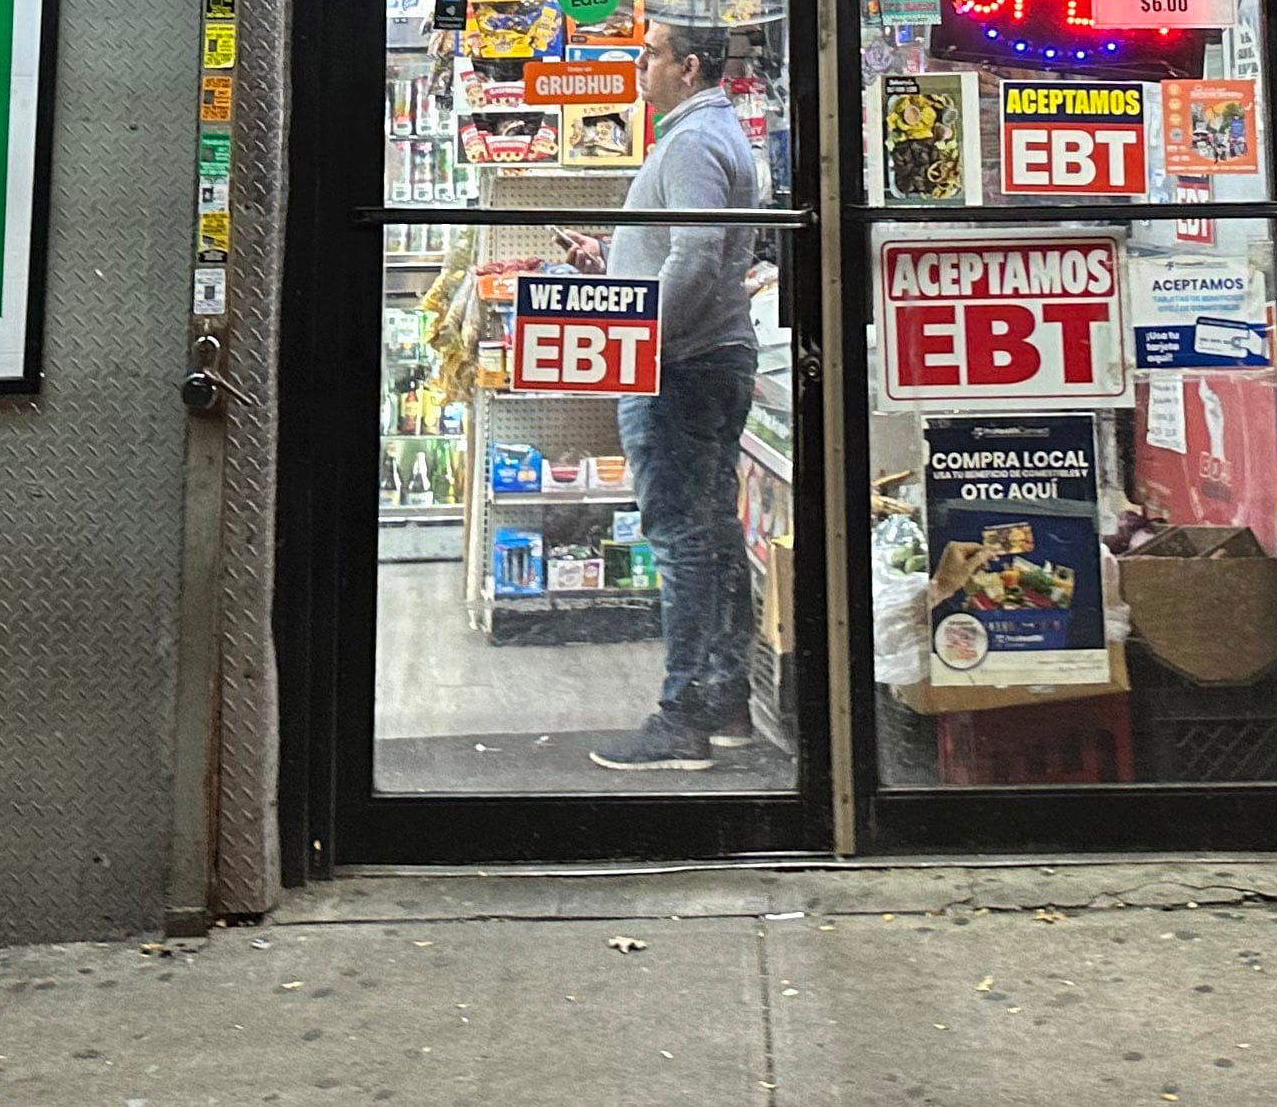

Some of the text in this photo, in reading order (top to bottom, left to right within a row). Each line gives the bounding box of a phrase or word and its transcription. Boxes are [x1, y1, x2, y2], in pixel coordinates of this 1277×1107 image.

[535, 75, 624, 96] GRUBHUB
[1006, 89, 1140, 116] ACEPTAMOS
[1010, 128, 1137, 186] EBT
[892, 249, 1112, 297] ACEPTAMOS
[1152, 278, 1244, 292] ACEPTAMOS
[529, 284, 648, 313] WE ACCEPT
[522, 323, 650, 385] EBT
[894, 303, 1110, 387] EBT
[932, 450, 1089, 469] COMPRA LOCAL
[961, 478, 1058, 500] OTC AQUÍ
